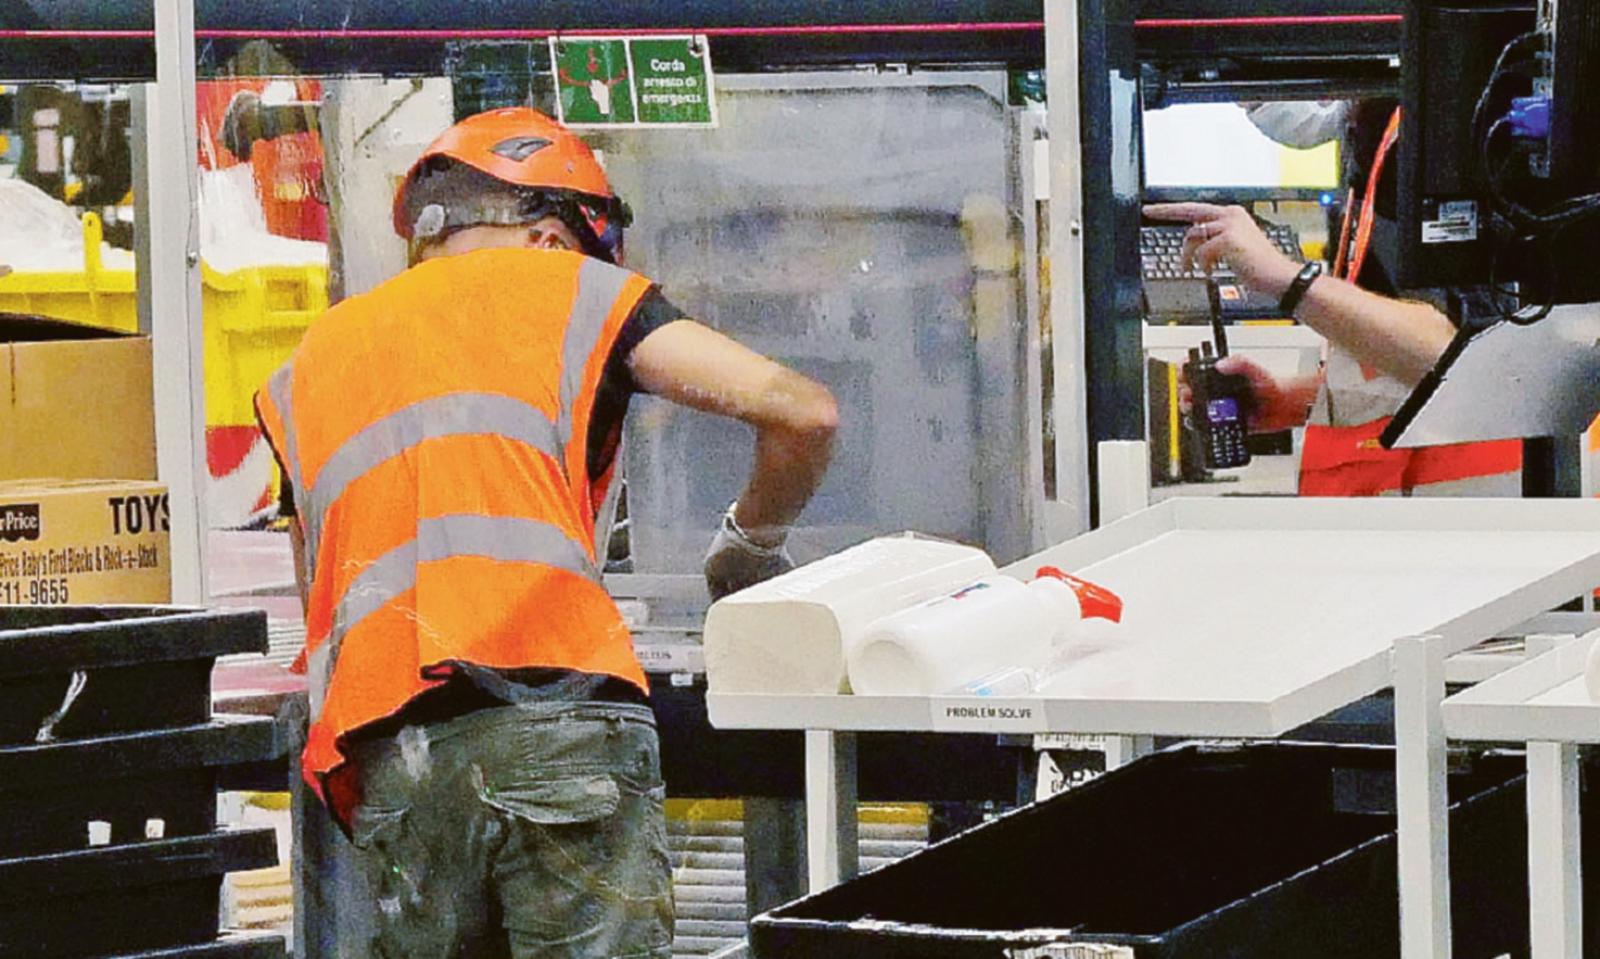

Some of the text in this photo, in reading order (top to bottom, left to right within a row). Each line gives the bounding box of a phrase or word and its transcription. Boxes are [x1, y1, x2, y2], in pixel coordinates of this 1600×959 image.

[650, 58, 686, 72] Corda
[946, 707, 1033, 719] PROBLEM SOLVE
